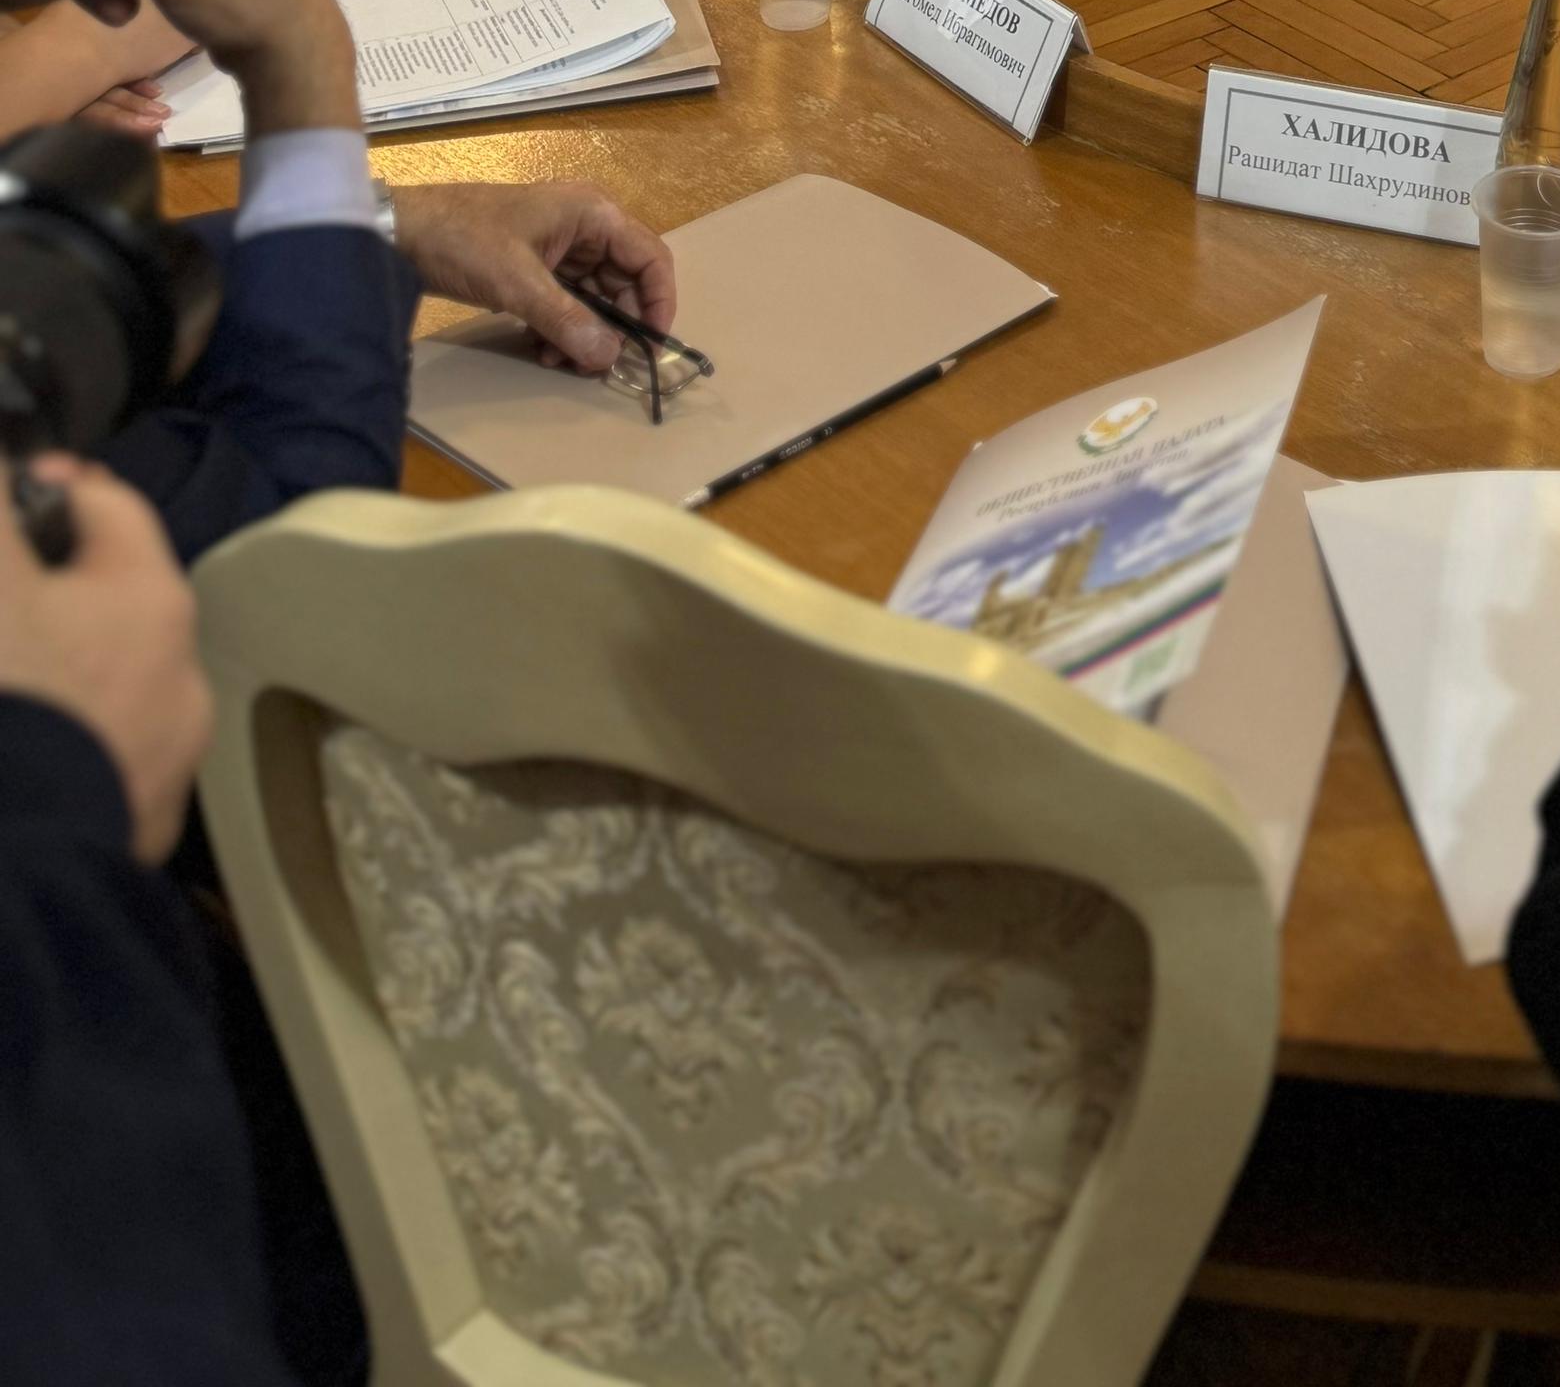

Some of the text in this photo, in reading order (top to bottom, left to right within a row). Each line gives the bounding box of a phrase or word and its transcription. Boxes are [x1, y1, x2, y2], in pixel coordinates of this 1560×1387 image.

[944, 9, 1026, 78] Ибрагимович
[1281, 113, 1451, 163] ХАЛИДОВА
[1228, 145, 1471, 206] Рашидат Шахрудинов
